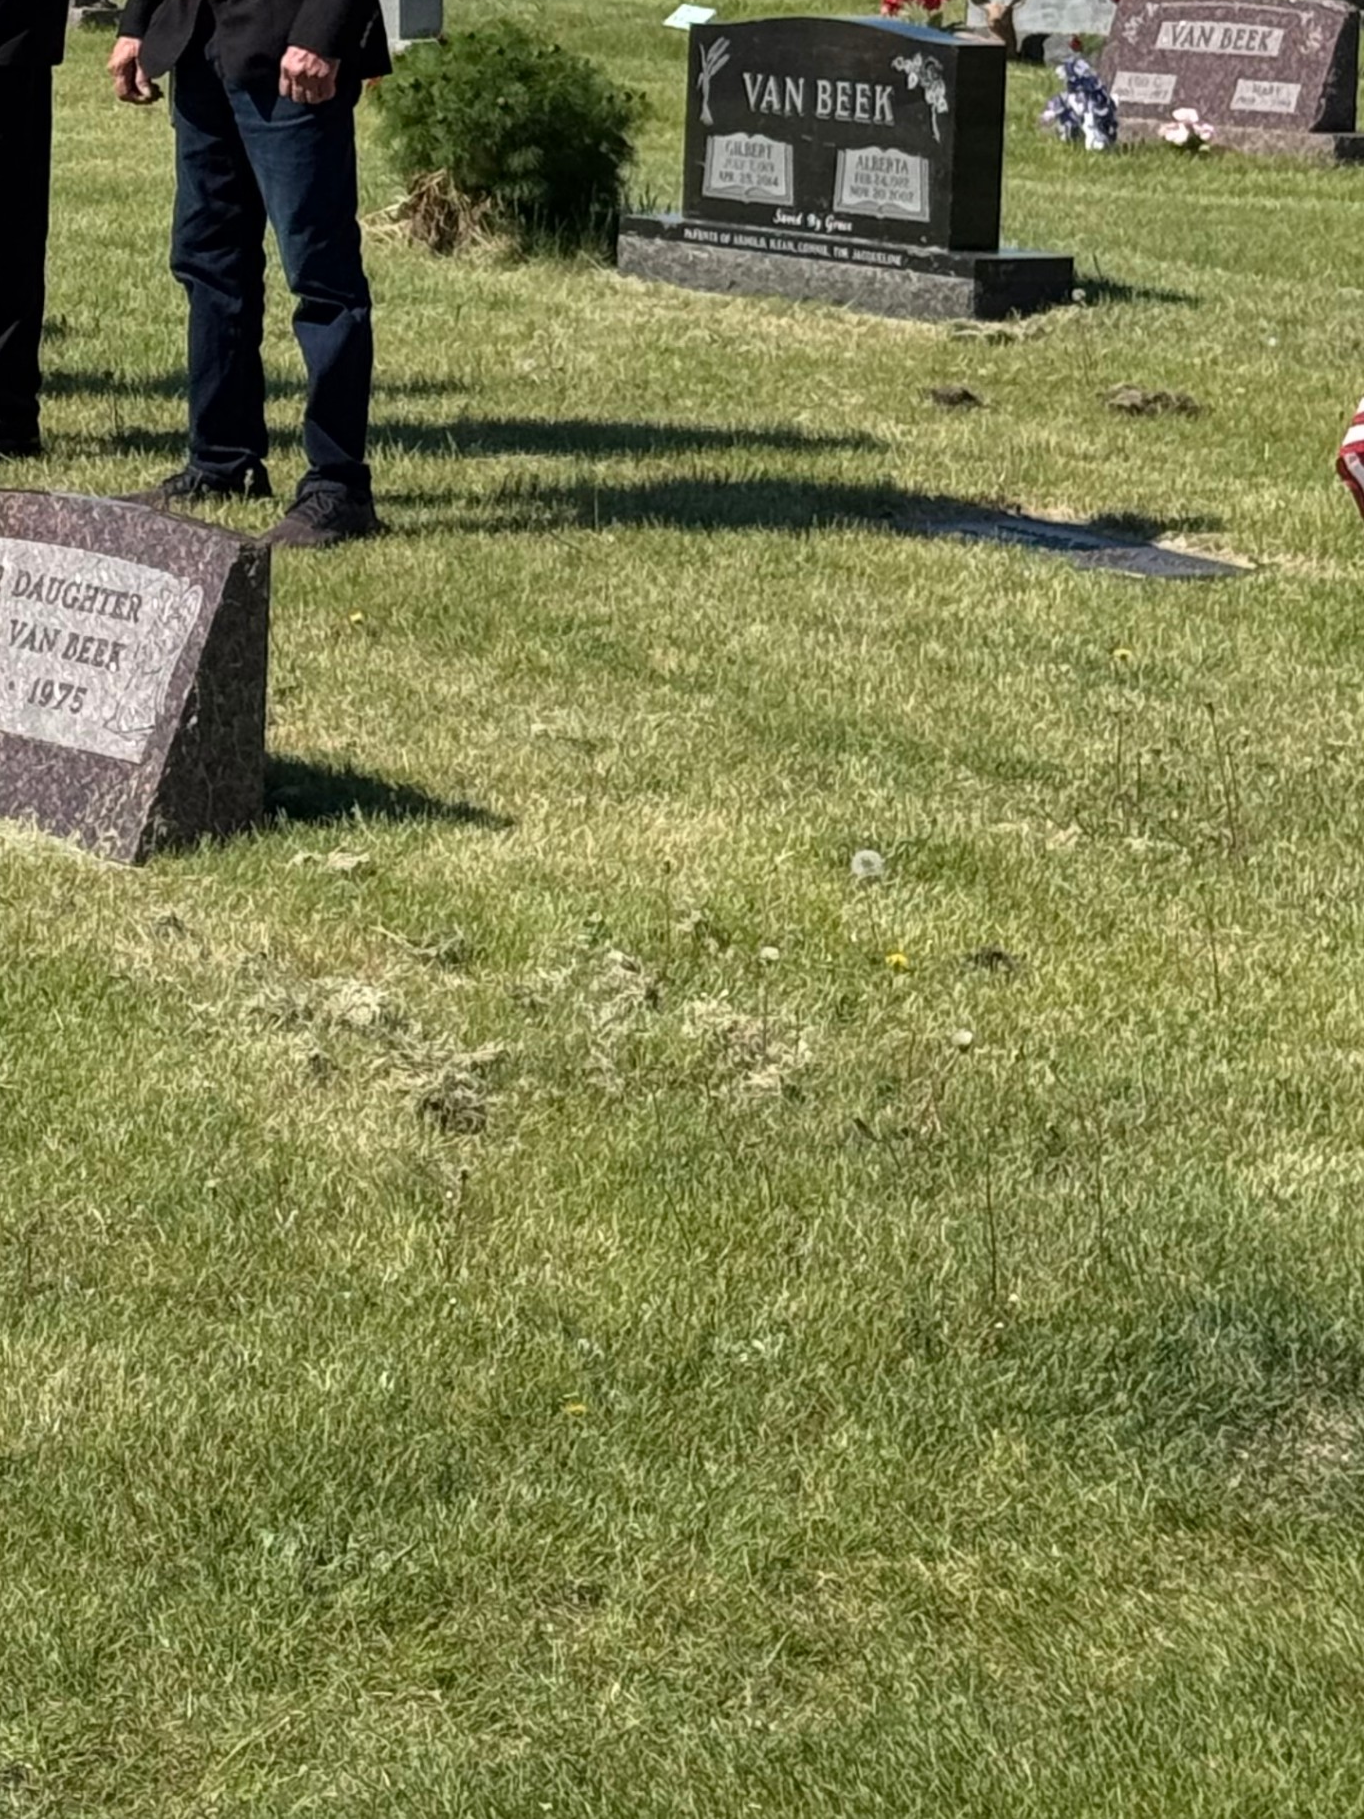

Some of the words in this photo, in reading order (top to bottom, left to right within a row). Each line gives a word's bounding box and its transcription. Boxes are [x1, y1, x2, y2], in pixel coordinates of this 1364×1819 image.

[1170, 25, 1212, 48] VAN
[1220, 28, 1274, 52] BEEK
[742, 72, 805, 117] VAN
[815, 79, 895, 126] BEEK
[725, 140, 773, 160] GILBERT
[856, 154, 909, 175] ALBERTA
[720, 232, 732, 245] OF
[11, 568, 143, 623] DAUGHTER
[9, 619, 63, 654] VAN
[61, 632, 127, 672] BEEK
[27, 677, 88, 715] 1975
